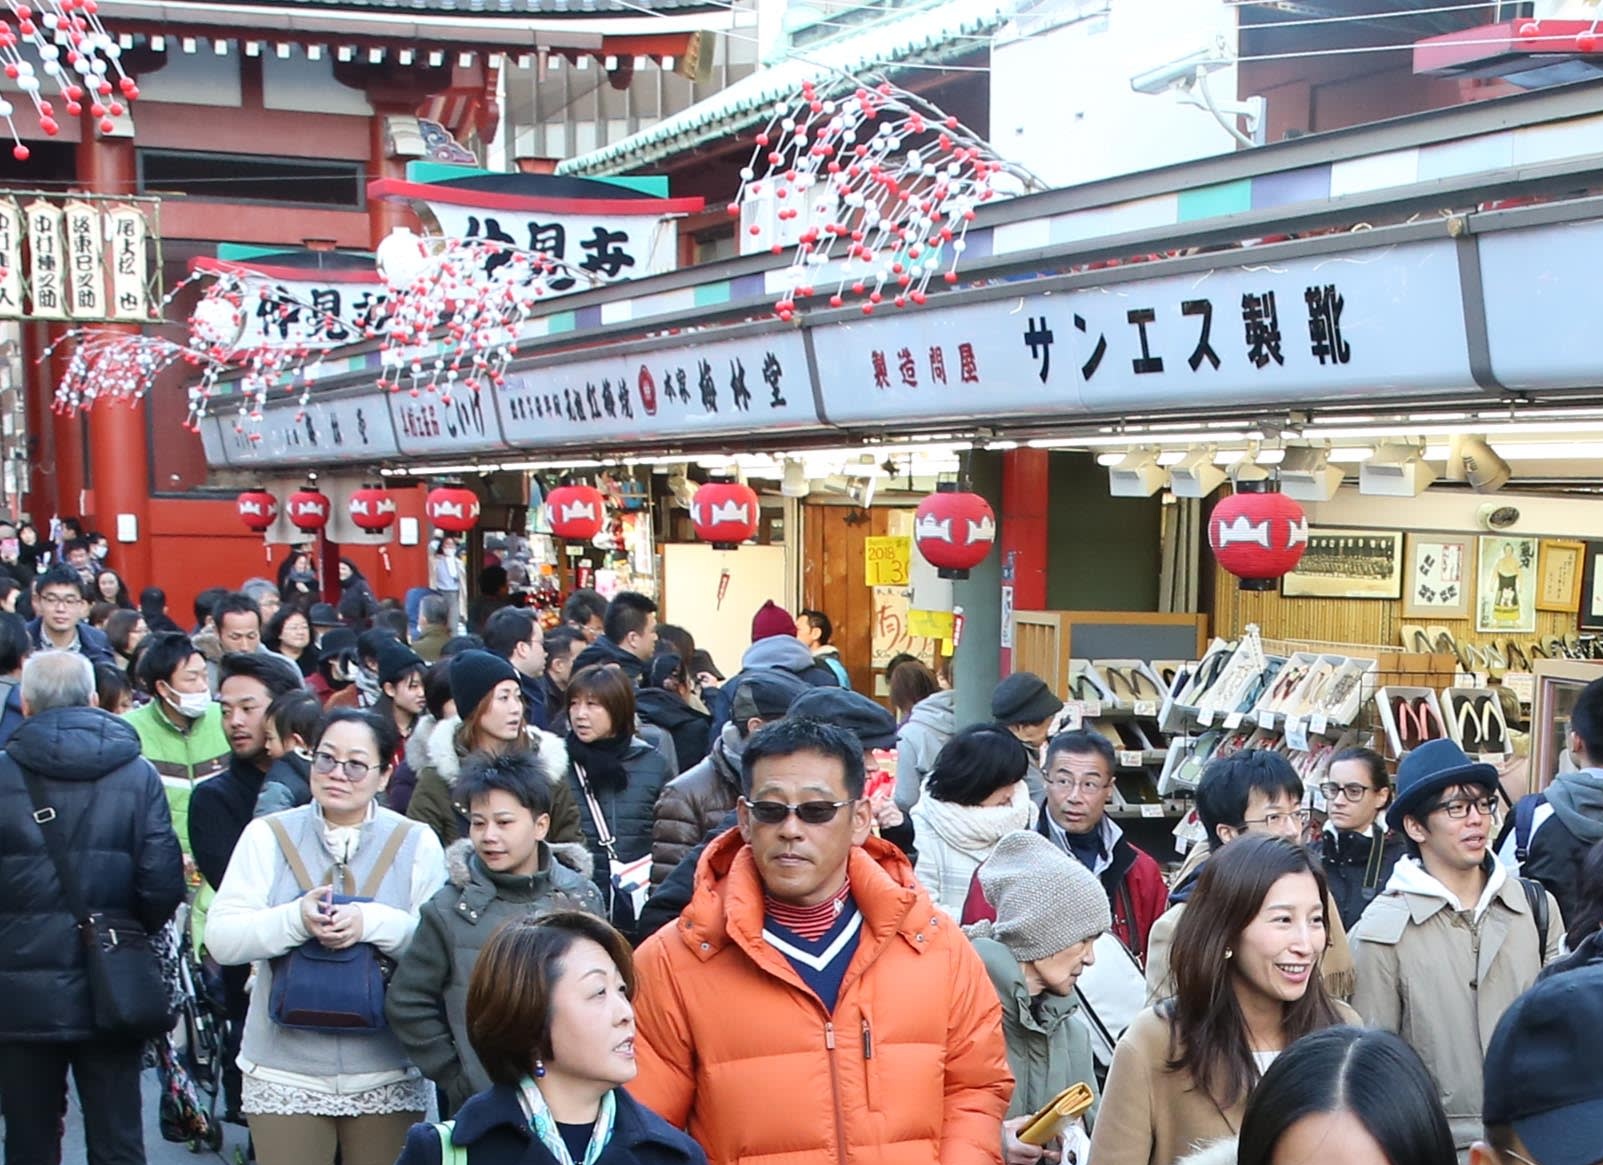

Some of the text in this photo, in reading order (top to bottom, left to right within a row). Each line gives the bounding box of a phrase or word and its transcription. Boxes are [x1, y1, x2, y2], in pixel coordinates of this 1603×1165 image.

[872, 284, 1351, 390] 製造問屋 サンエス製靴
[868, 546, 896, 560] 2018
